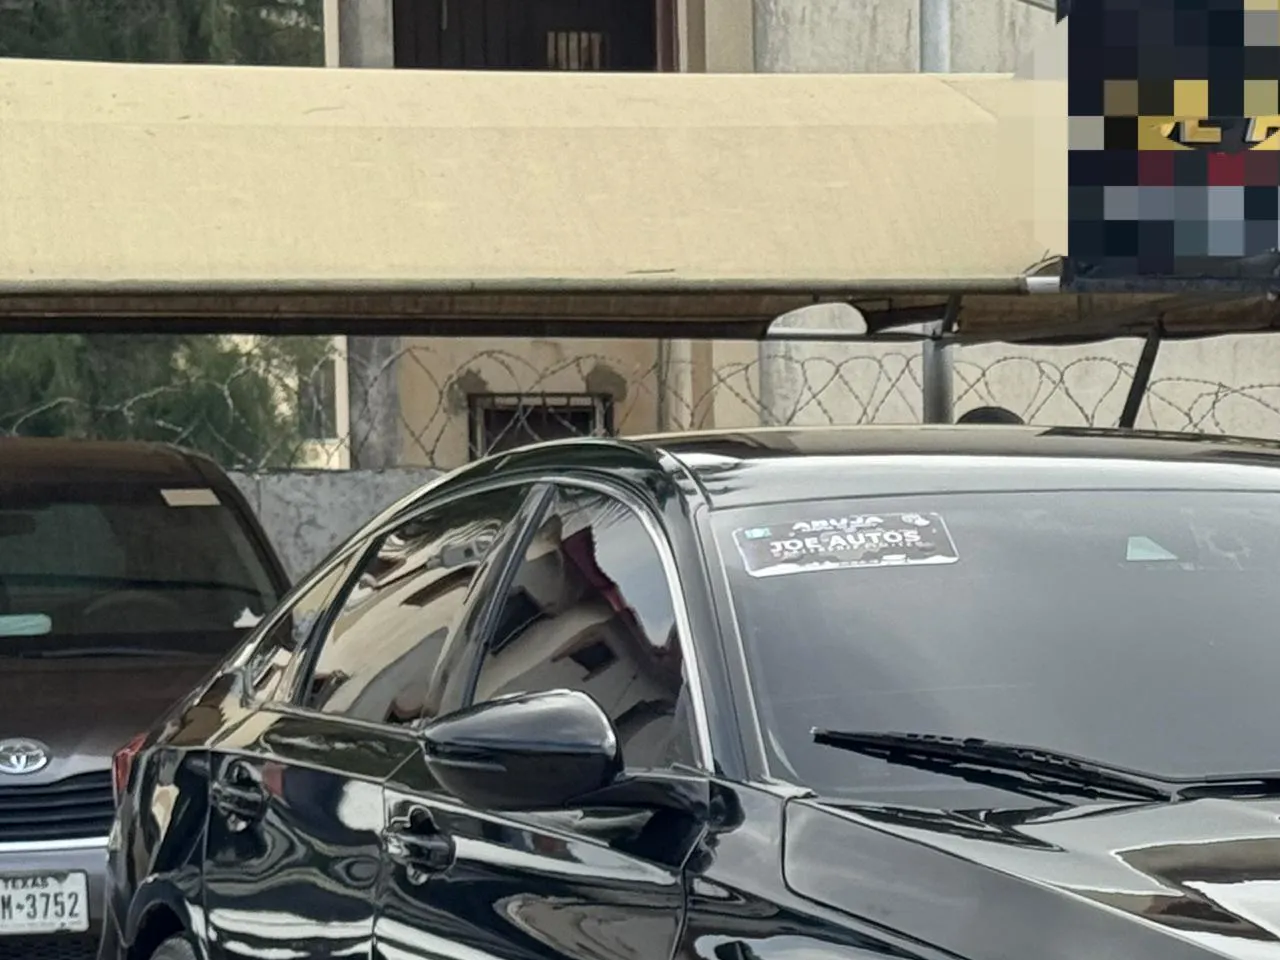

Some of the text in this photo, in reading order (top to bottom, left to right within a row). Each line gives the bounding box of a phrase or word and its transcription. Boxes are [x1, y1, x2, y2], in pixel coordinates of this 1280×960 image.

[770, 537, 822, 554] JOE
[828, 529, 921, 551] AUTOS
[2, 876, 49, 890] TEXAS
